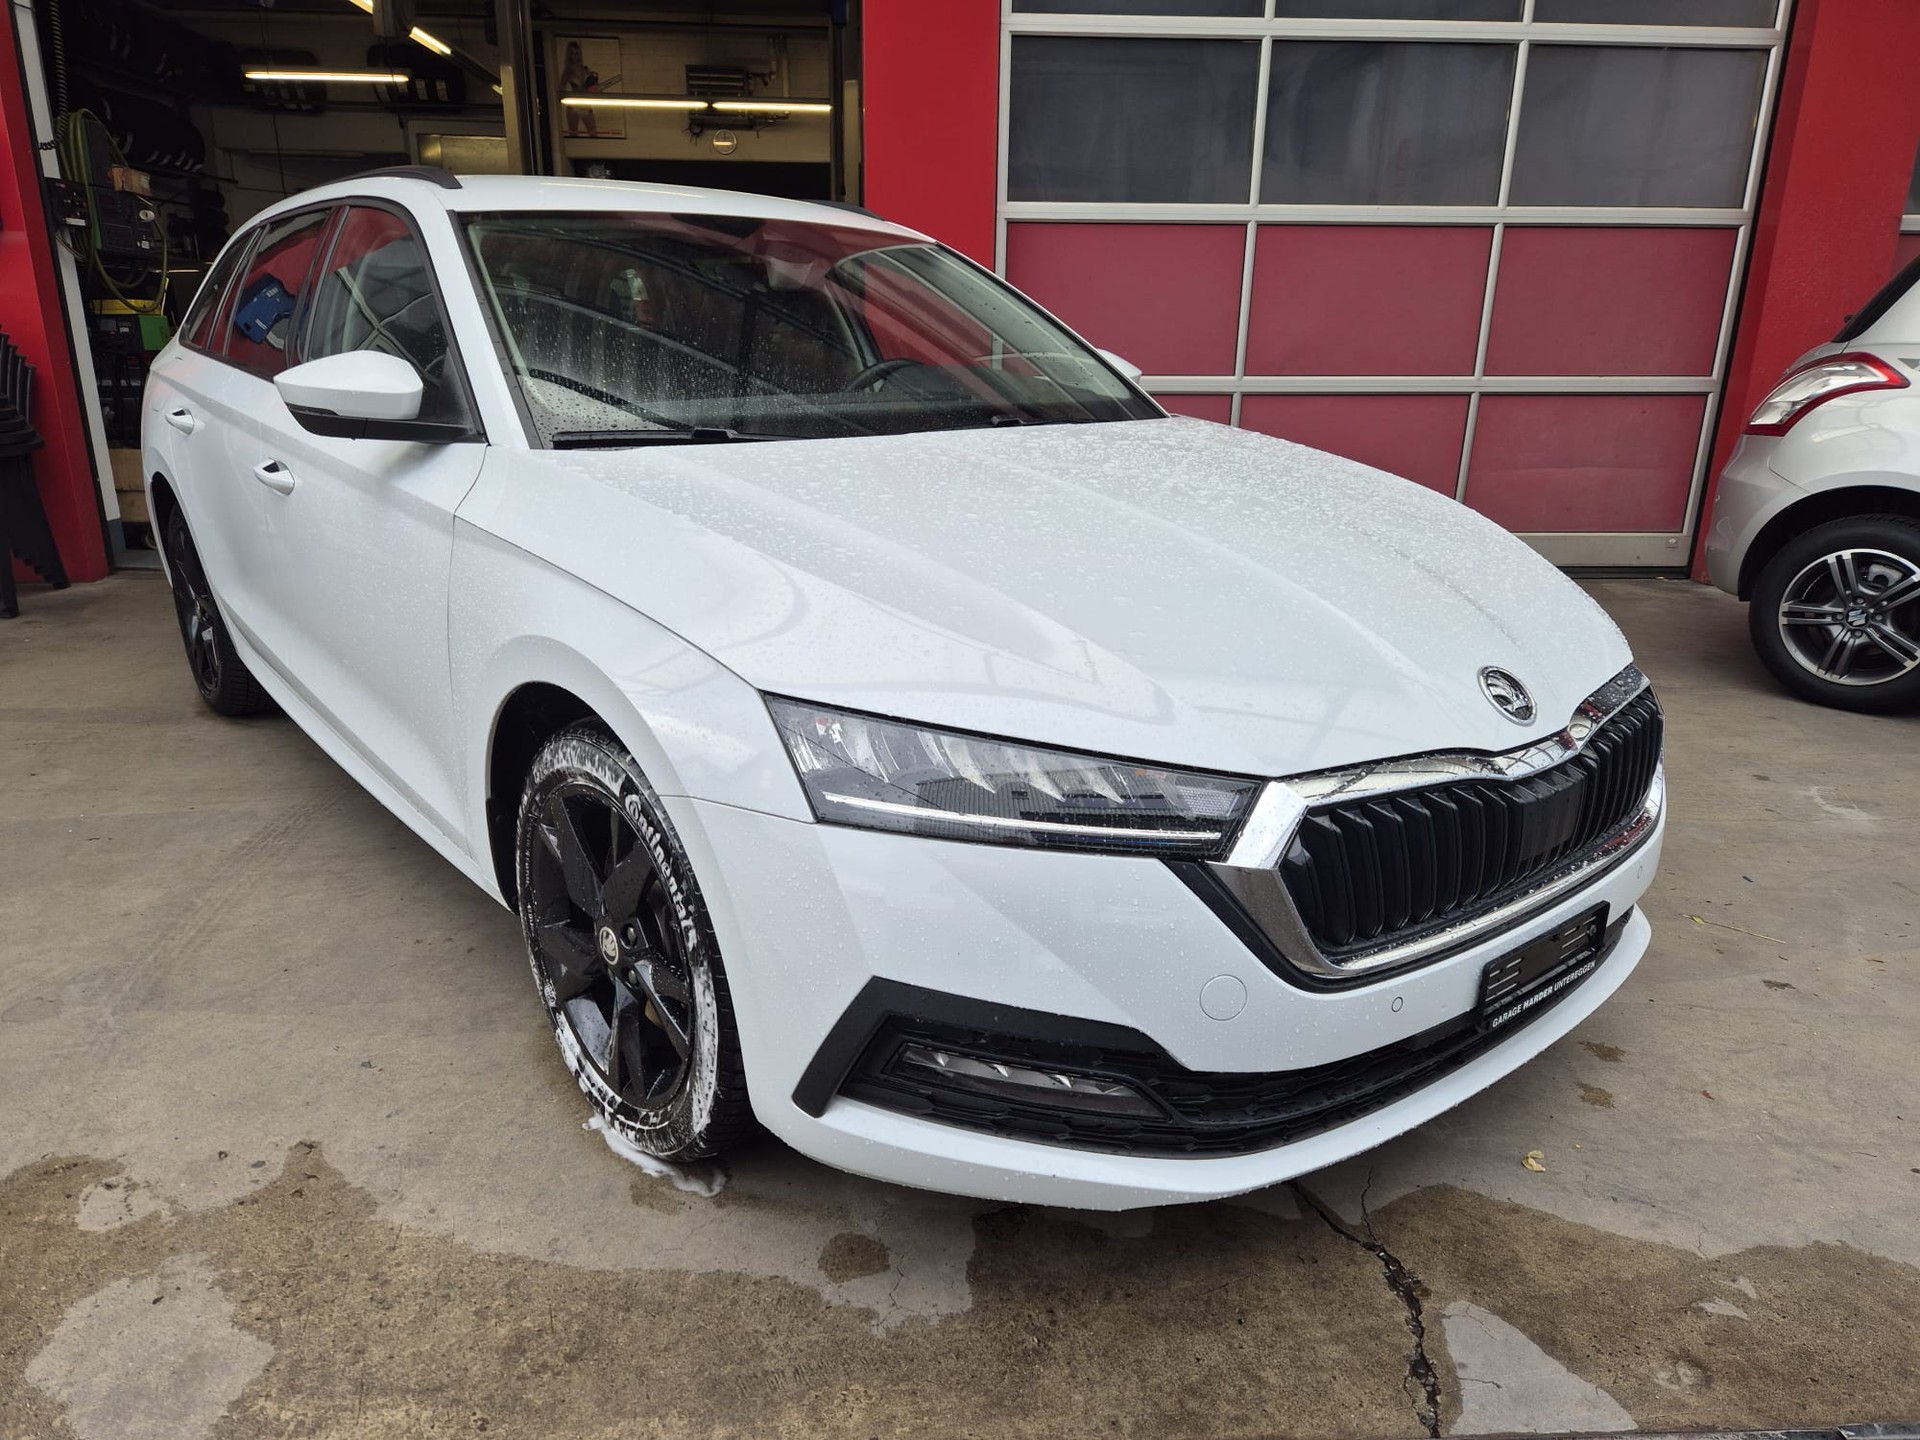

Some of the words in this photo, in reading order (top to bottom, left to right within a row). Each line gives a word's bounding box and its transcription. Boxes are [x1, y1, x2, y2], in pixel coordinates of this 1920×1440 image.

[624, 793, 695, 929] Continental
[1492, 1003, 1523, 1028] GARAGE
[1554, 960, 1597, 991] UNTEREGGEN
